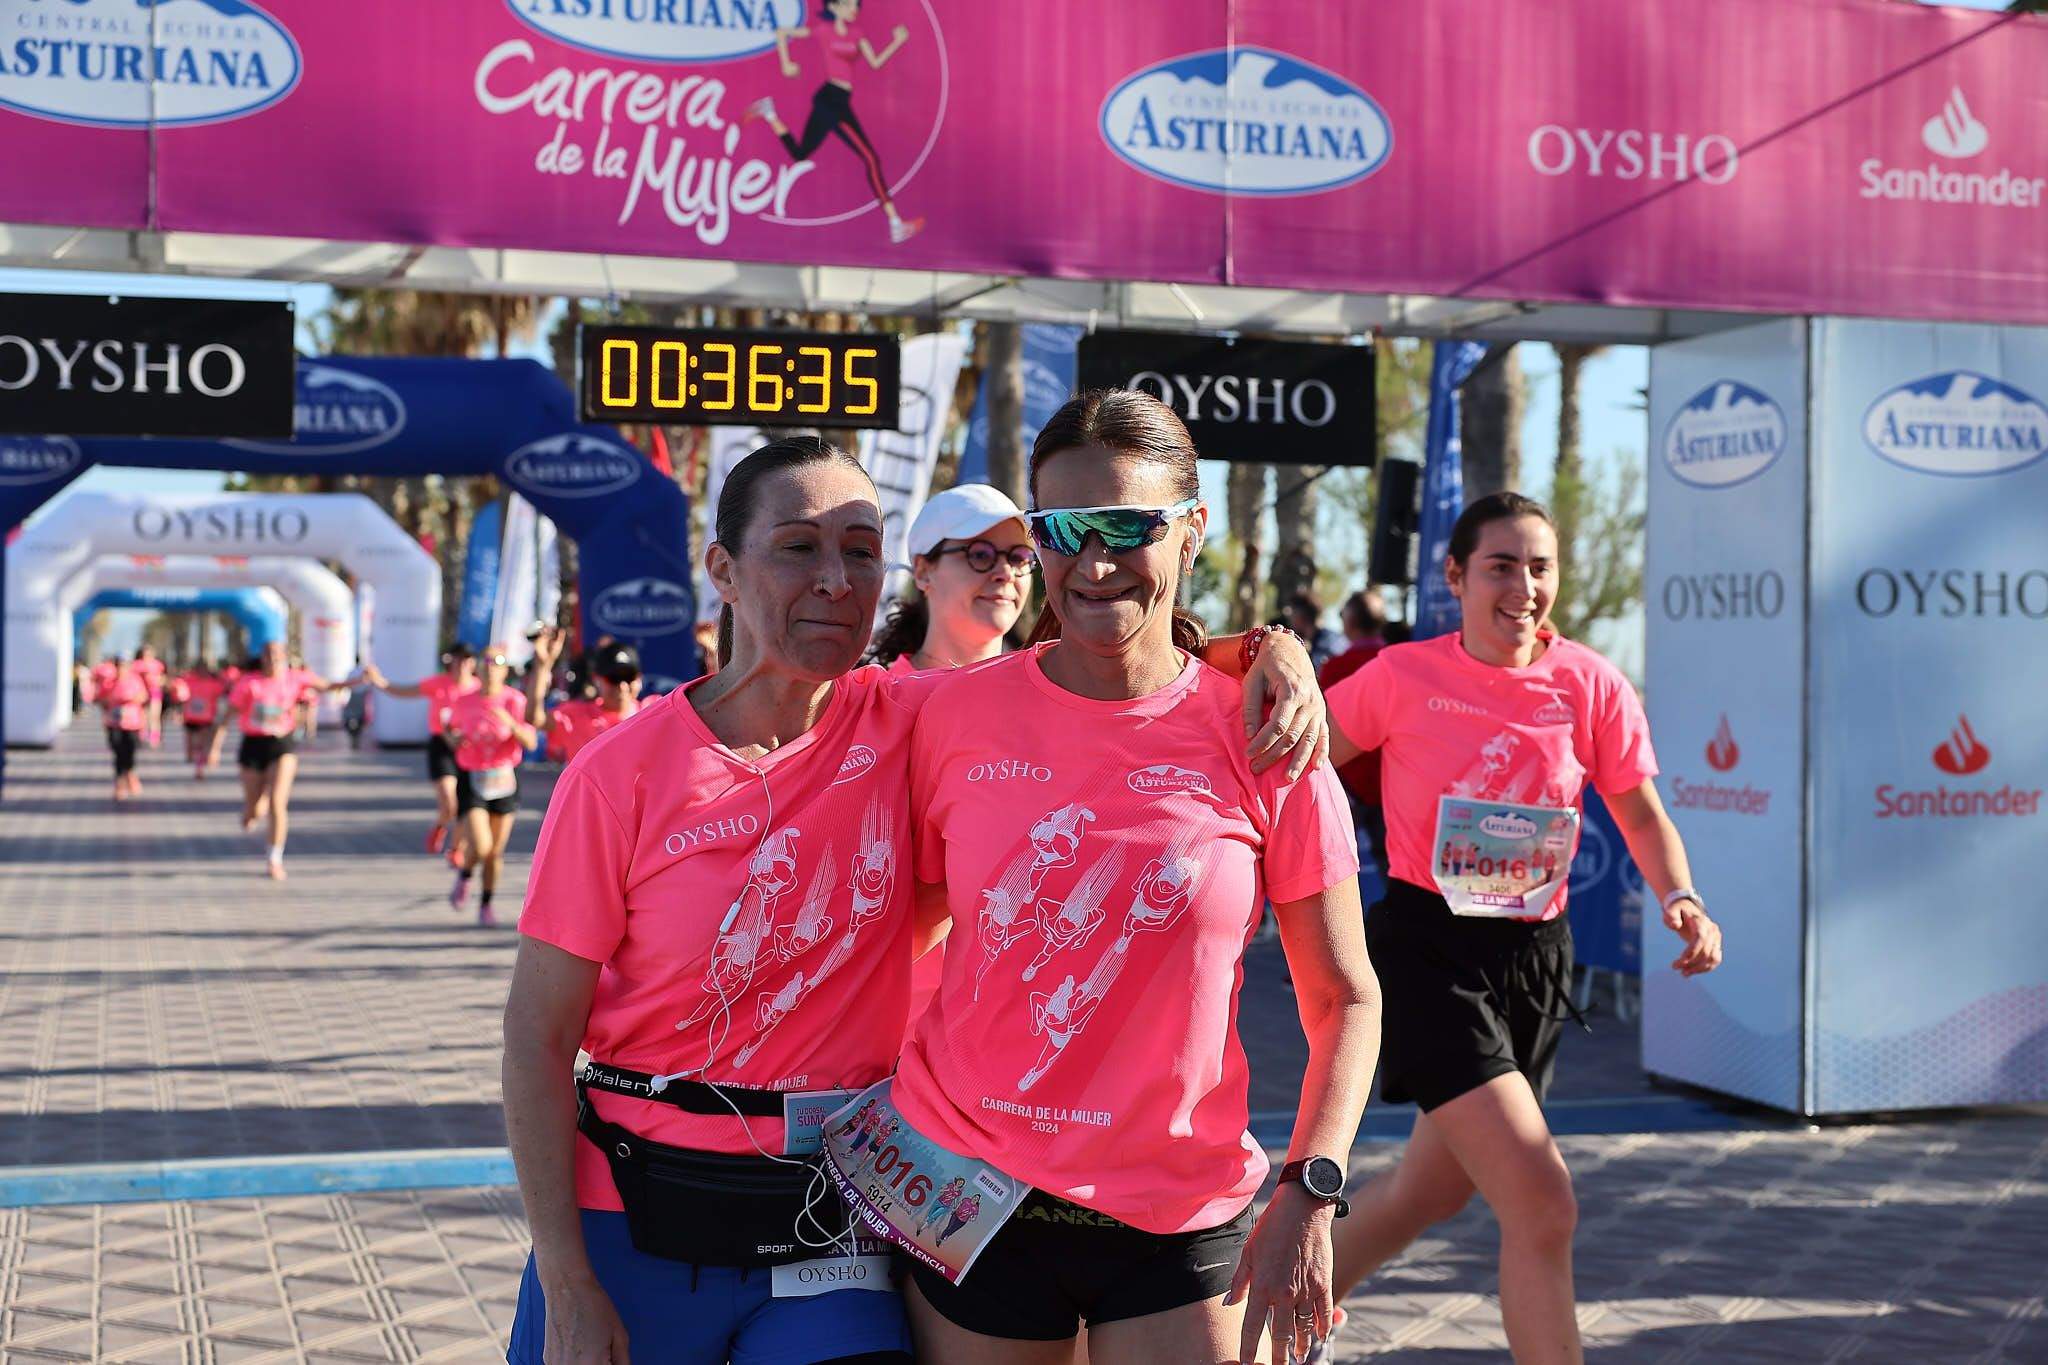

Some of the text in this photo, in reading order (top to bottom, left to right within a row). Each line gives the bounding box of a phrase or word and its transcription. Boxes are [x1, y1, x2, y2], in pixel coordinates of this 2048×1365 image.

[17, 11, 135, 35] CENTRAL
[528, 0, 780, 31] TURIANA
[0, 37, 272, 89] STURIANA
[474, 39, 727, 131] Carrera
[1127, 96, 1368, 161] ASTURIANA
[1527, 124, 1739, 185] OYSHO
[535, 122, 815, 245] de la Mujer
[1859, 158, 2044, 208] Santander
[0, 334, 246, 398] OYSHO
[602, 339, 878, 415] 00:36:35
[1878, 408, 2043, 451] ASTURIANA
[132, 505, 310, 545] OYSHO
[1662, 569, 1785, 623] OYSHO
[1855, 566, 2048, 620] OYSHO
[968, 759, 1052, 783] OYSHO
[1671, 776, 1773, 817] Santander
[1874, 784, 2043, 819] Santander
[664, 813, 759, 856] OYSHO
[1477, 857, 1527, 881] 016
[592, 1068, 661, 1097] Kalen
[981, 1097, 1113, 1127] CARRERA DE LA MUJER
[1031, 1120, 1060, 1135] 2024
[874, 1144, 934, 1208] 016
[821, 1137, 848, 1191] CARRERA
[843, 1187, 861, 1206] DE
[861, 1206, 891, 1239] MUJER
[897, 1235, 948, 1275] VALENCIA
[866, 1183, 894, 1215] 5914
[757, 1244, 795, 1255] SPORT
[798, 1264, 867, 1283] OYSHO
